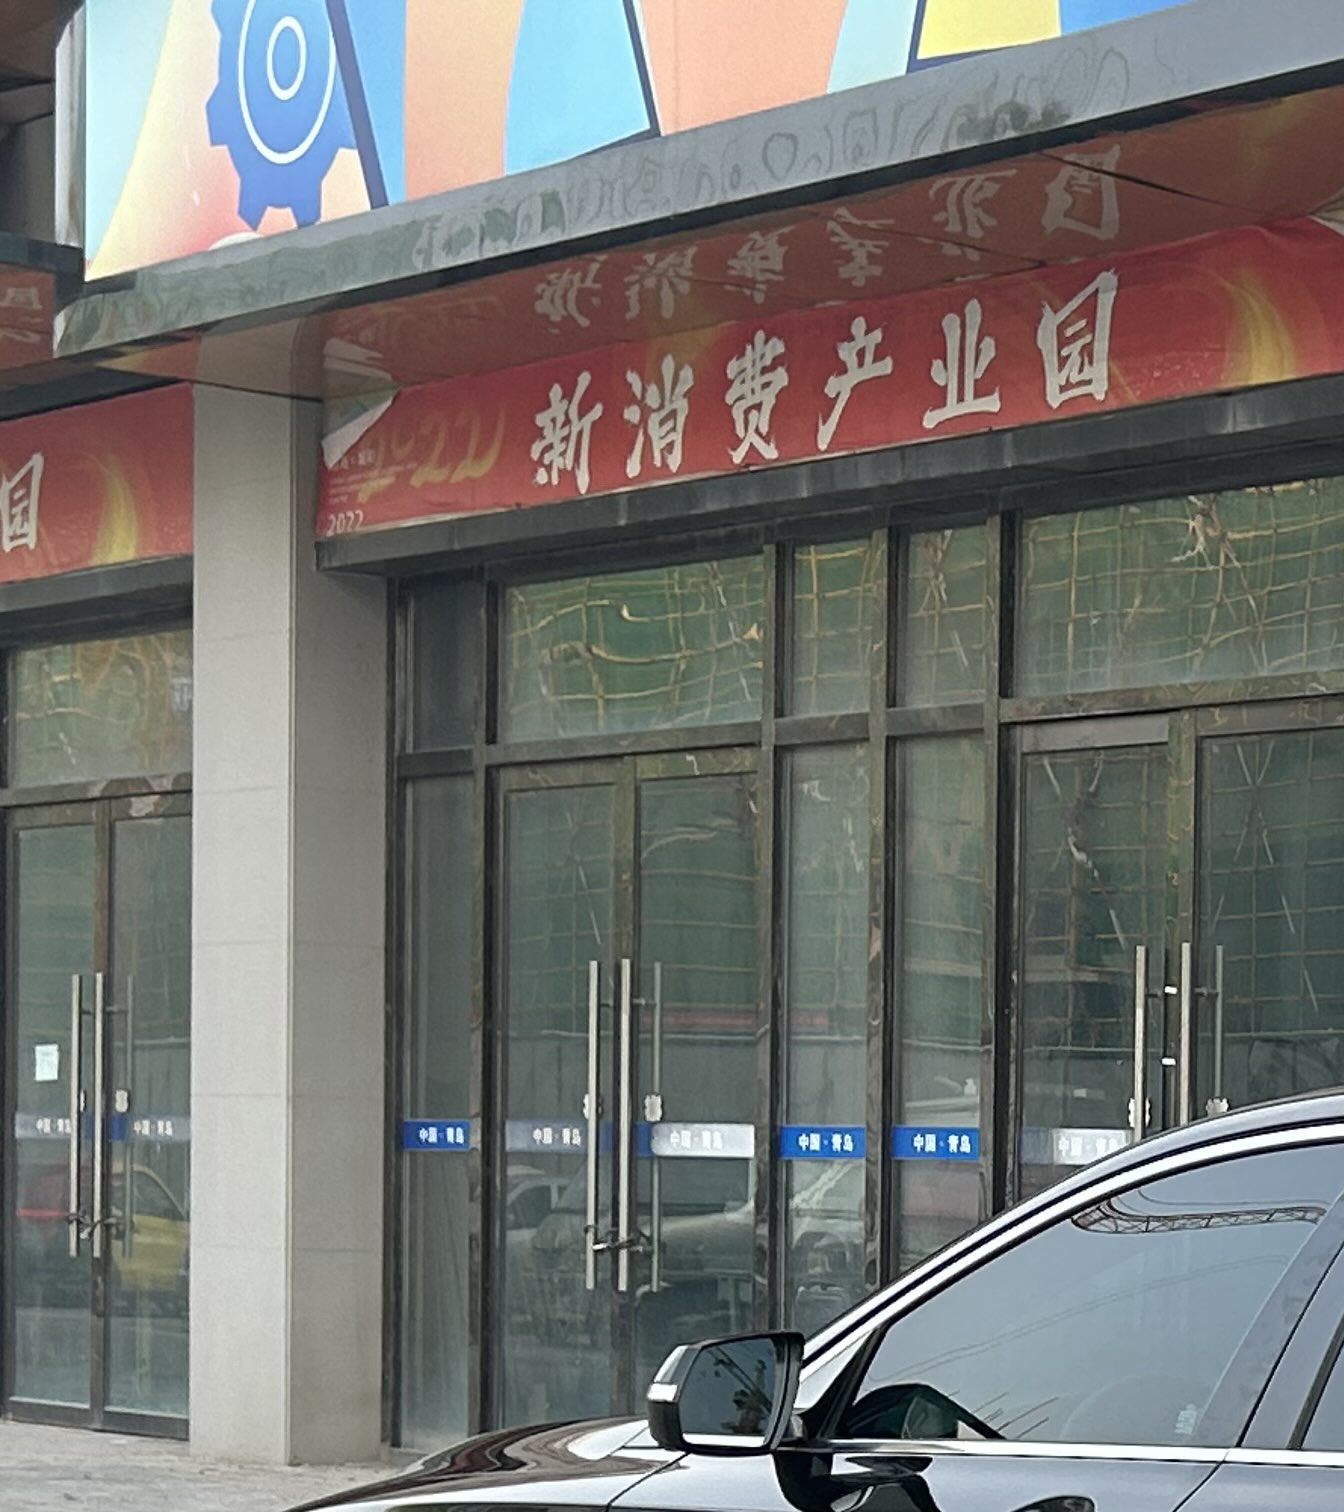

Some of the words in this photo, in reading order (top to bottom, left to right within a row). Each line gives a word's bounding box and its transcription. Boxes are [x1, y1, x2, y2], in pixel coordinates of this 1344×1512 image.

[530, 267, 1119, 496] 新消费产业园
